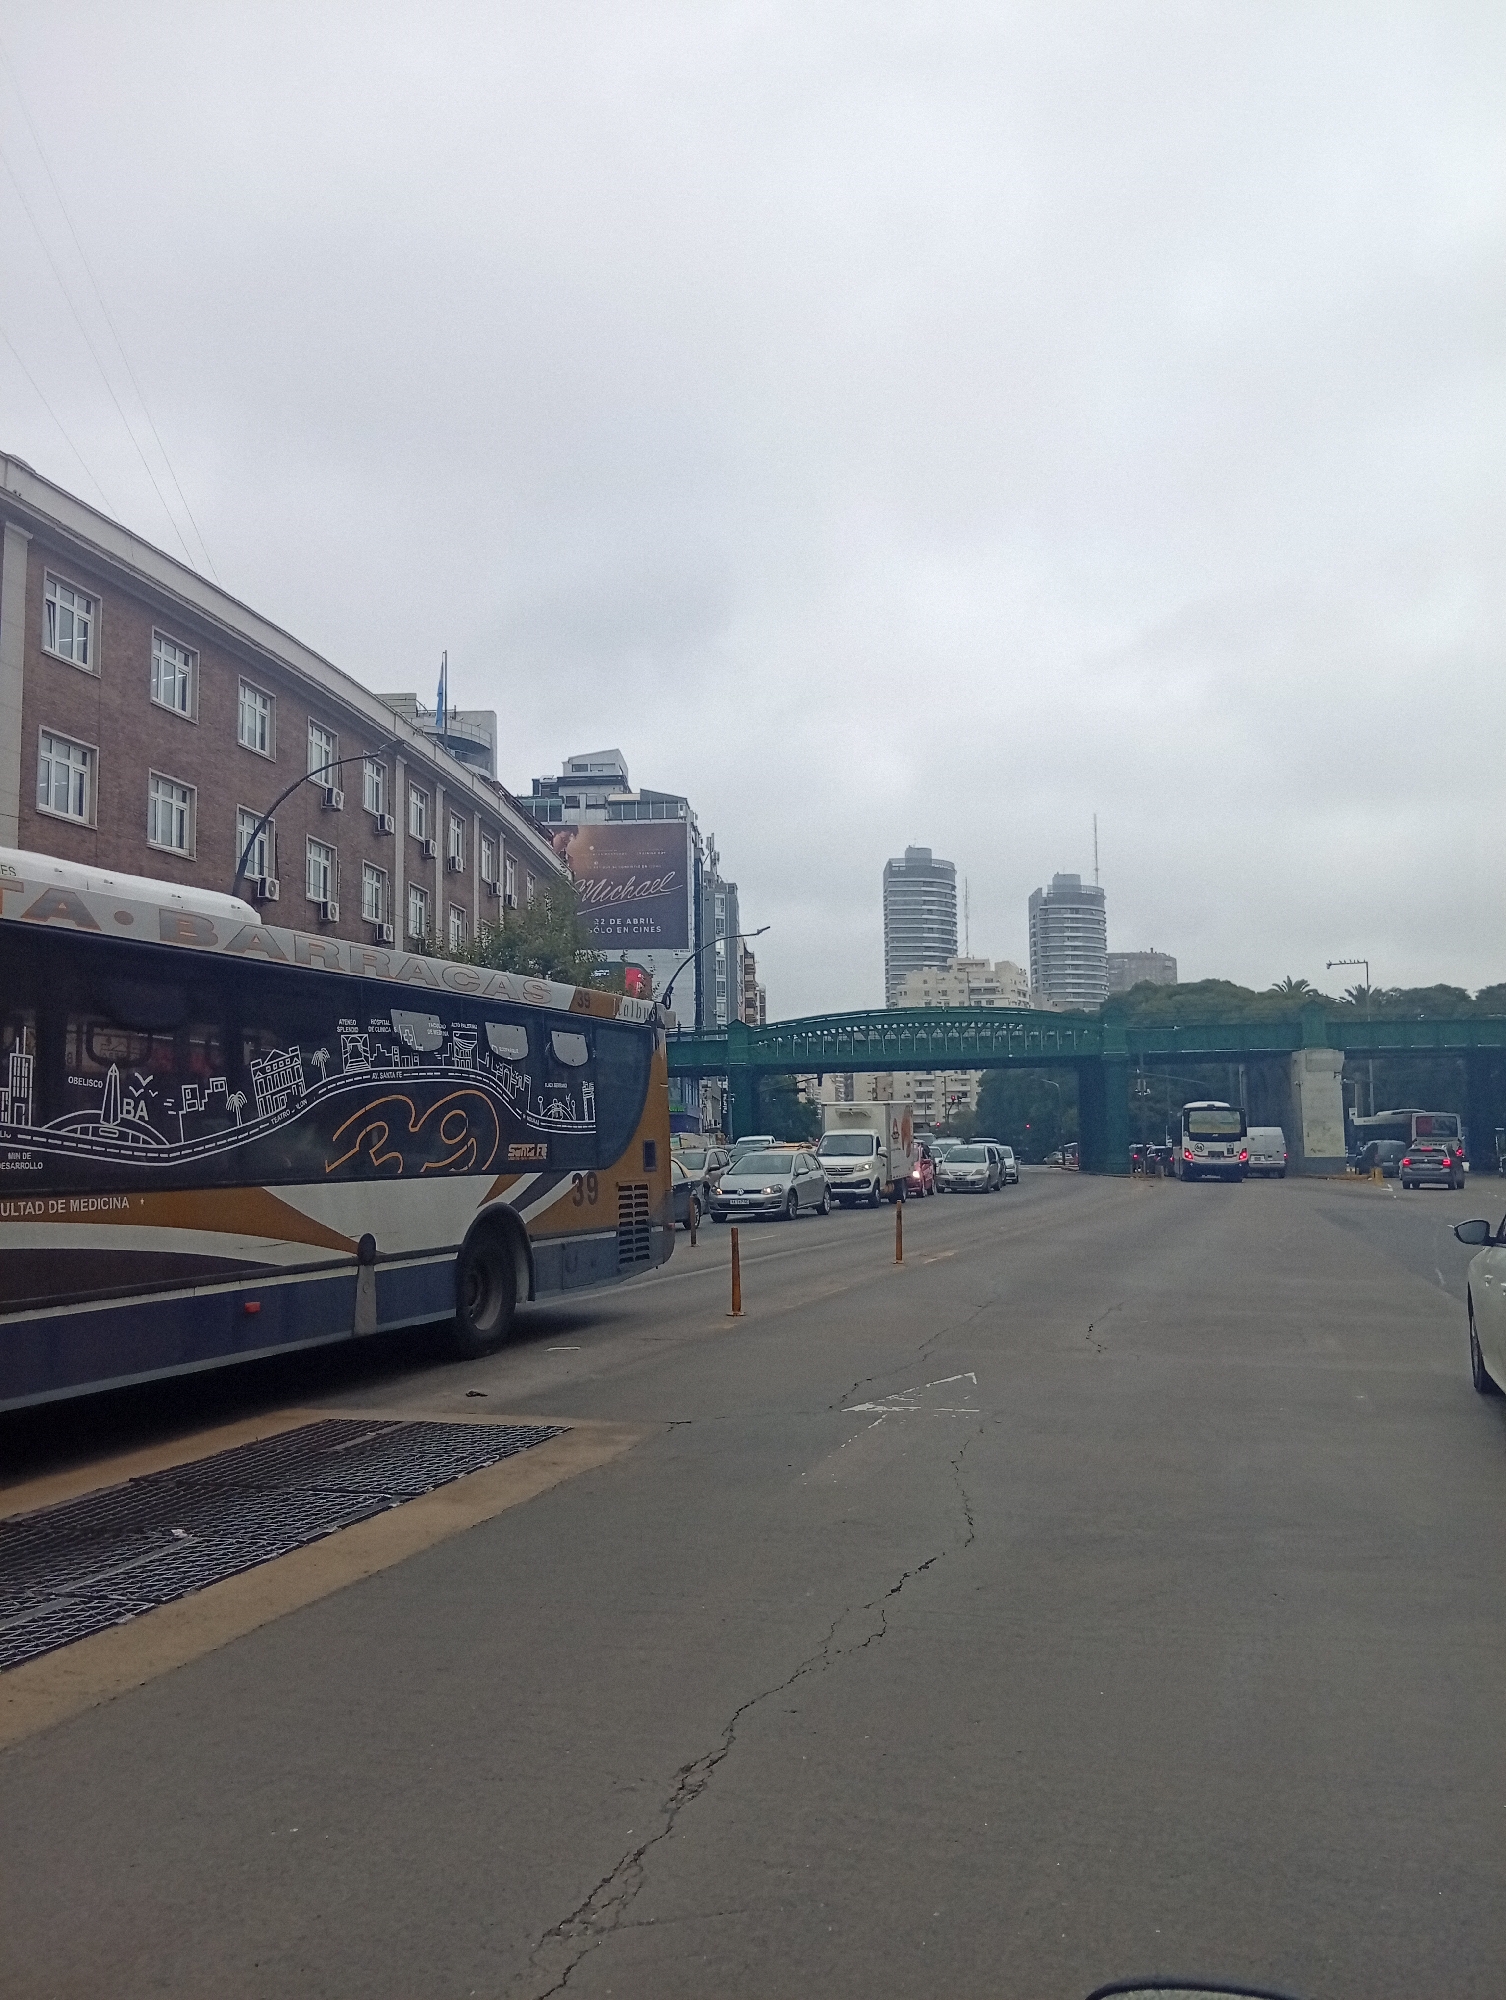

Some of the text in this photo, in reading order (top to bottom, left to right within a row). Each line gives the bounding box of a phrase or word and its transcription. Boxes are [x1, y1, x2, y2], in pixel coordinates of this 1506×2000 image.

[575, 871, 683, 903] Michael
[626, 917, 655, 925] ABRIL
[633, 925, 662, 933] CINES
[159, 908, 552, 1004] BARRACAS
[576, 989, 591, 1009] 39
[68, 1075, 103, 1089] OBELISCO
[123, 1097, 149, 1121] BA
[271, 1109, 291, 1125] TEATRO
[22, 1152, 32, 1160] DE
[571, 1172, 599, 1208] 39
[48, 1199, 66, 1214] DE
[70, 1196, 130, 1213] MEDICINA
